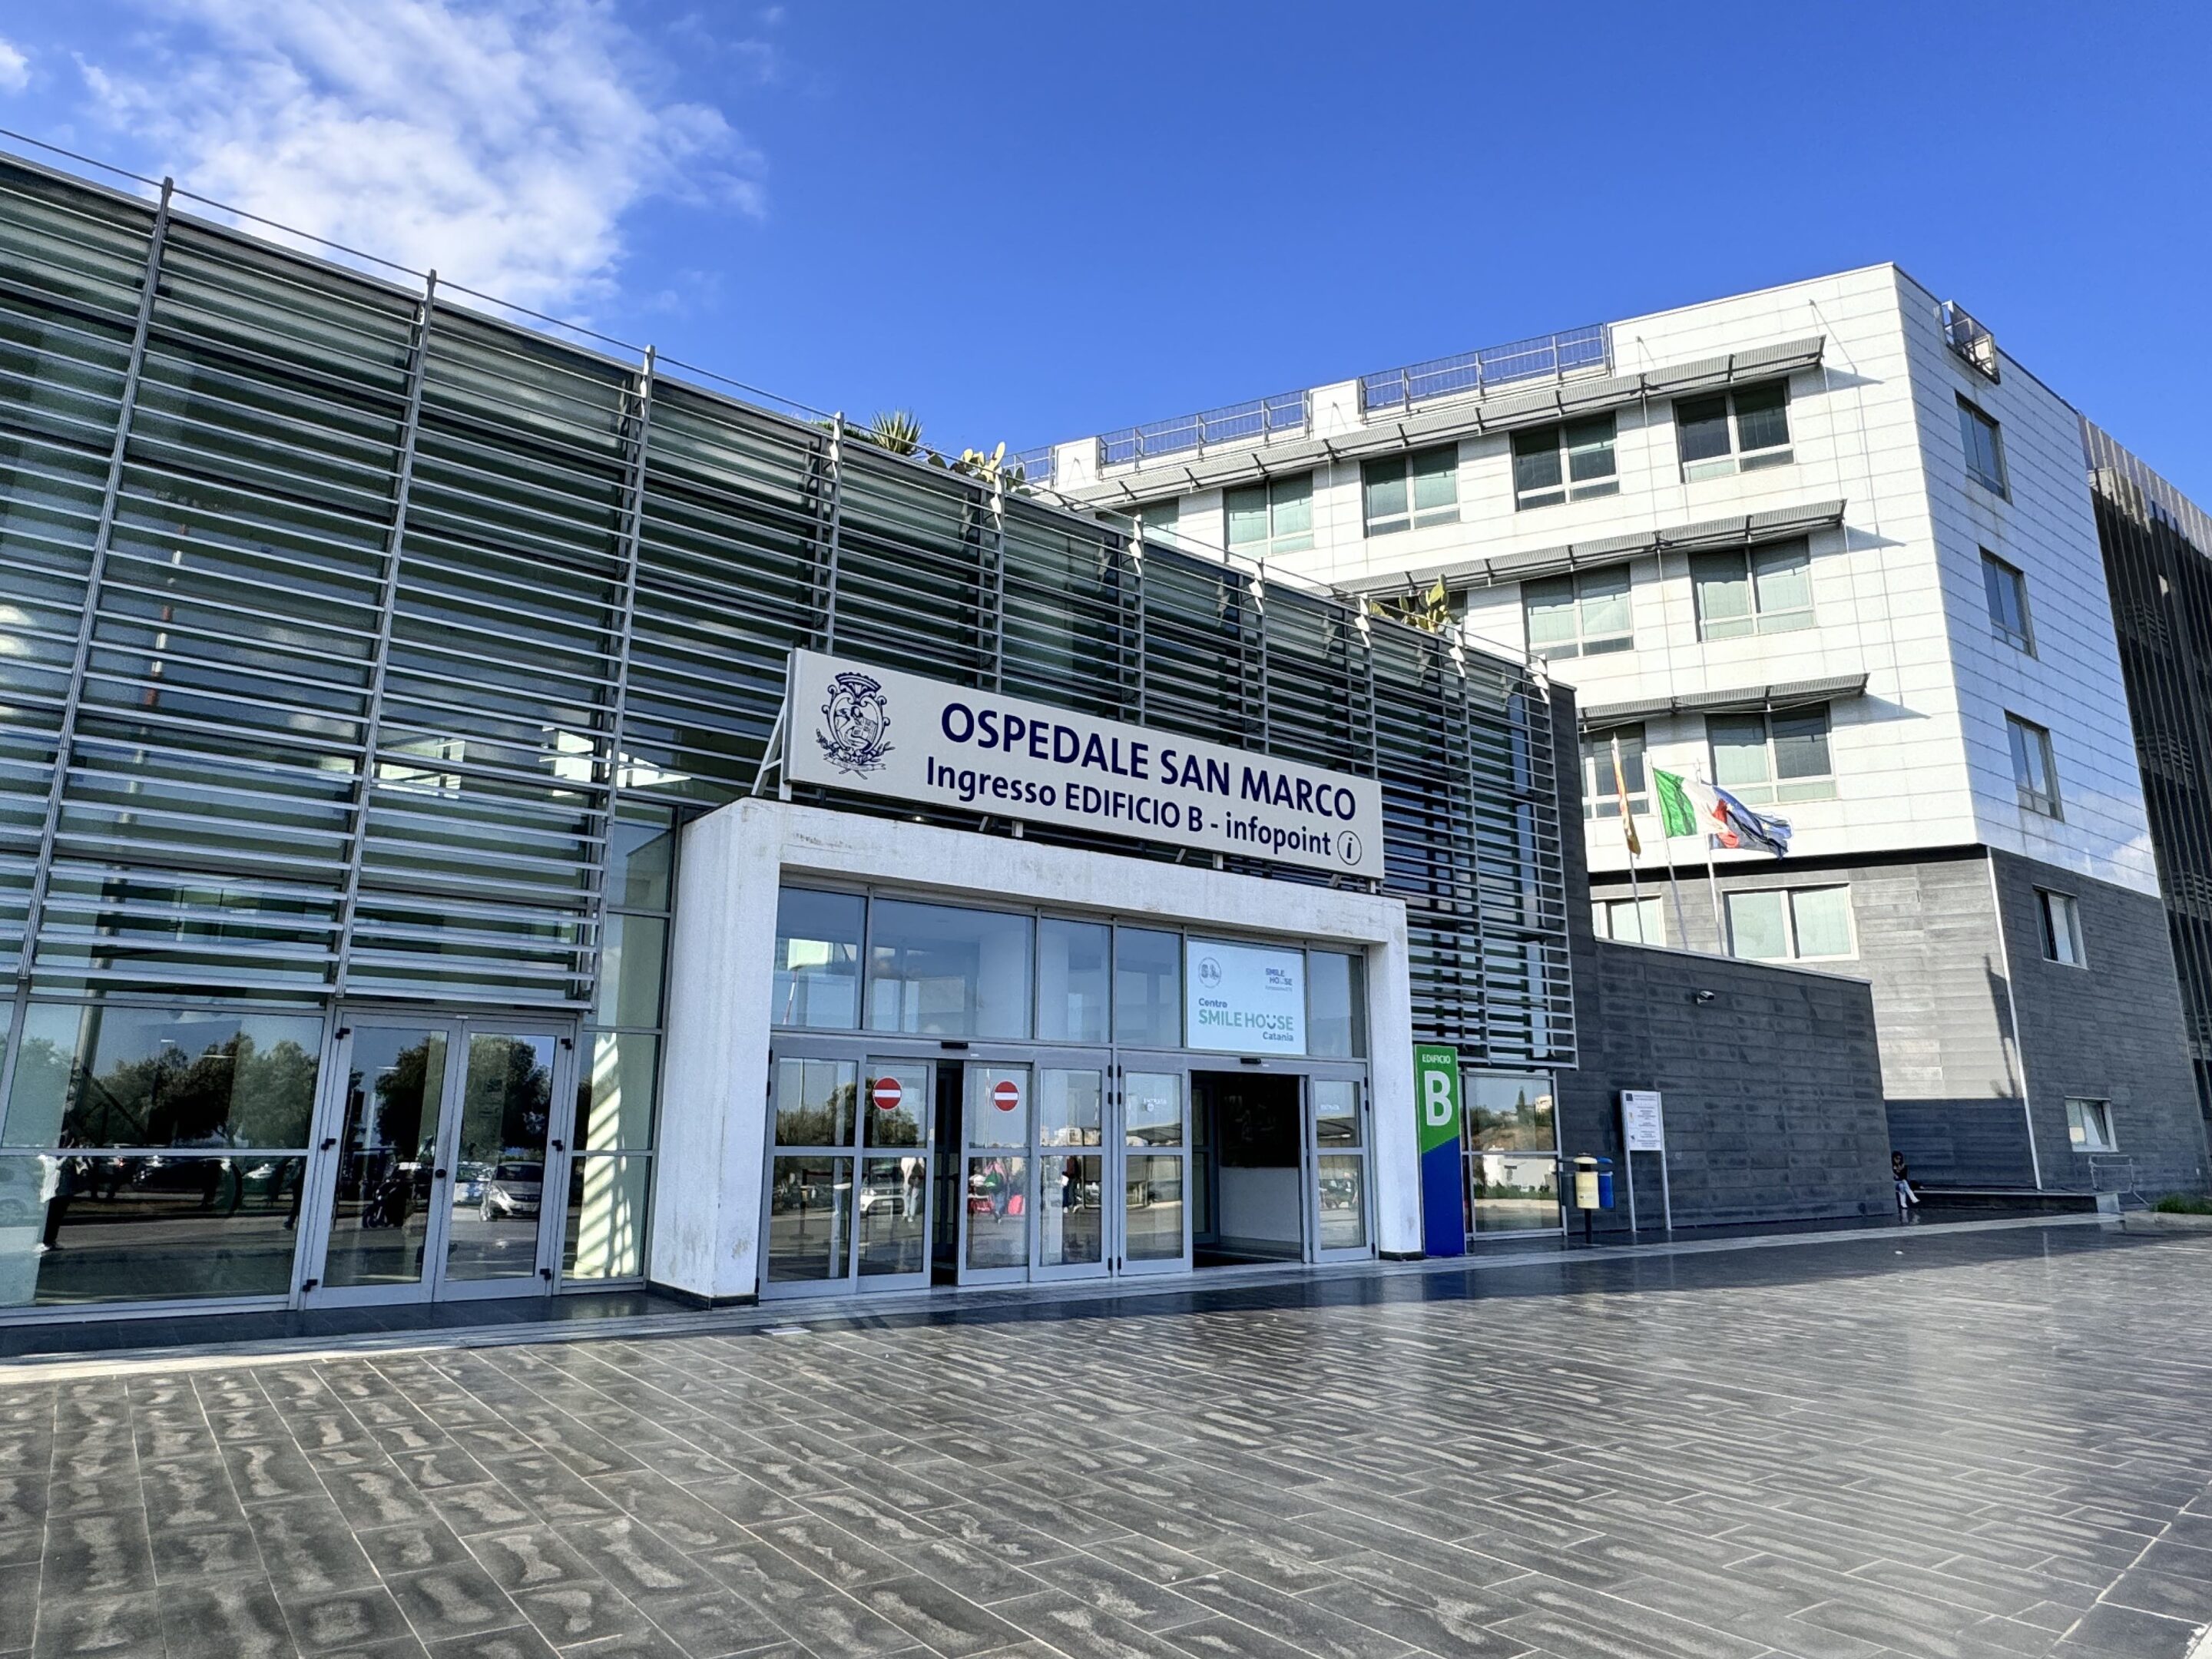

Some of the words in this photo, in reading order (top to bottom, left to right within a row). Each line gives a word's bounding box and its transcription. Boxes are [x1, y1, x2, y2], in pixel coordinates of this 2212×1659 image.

[942, 702, 1149, 780] OSPEDALE
[1161, 749, 1230, 796] SAN
[1240, 766, 1356, 821] MARCO
[927, 756, 1057, 803] Ingresso
[1065, 782, 1181, 829] EDIFICIO
[1188, 805, 1204, 833] B
[1226, 810, 1331, 855] infopoint
[1265, 968, 1285, 978] SMILE
[1269, 976, 1293, 986] HOSE
[1198, 997, 1228, 1008] Centro
[1198, 1008, 1242, 1028] SMILE
[1244, 1012, 1293, 1031] HOUSE
[1262, 1031, 1294, 1042] Catania
[1422, 1053, 1451, 1065] EDIFICIO
[1424, 1070, 1453, 1127] B
